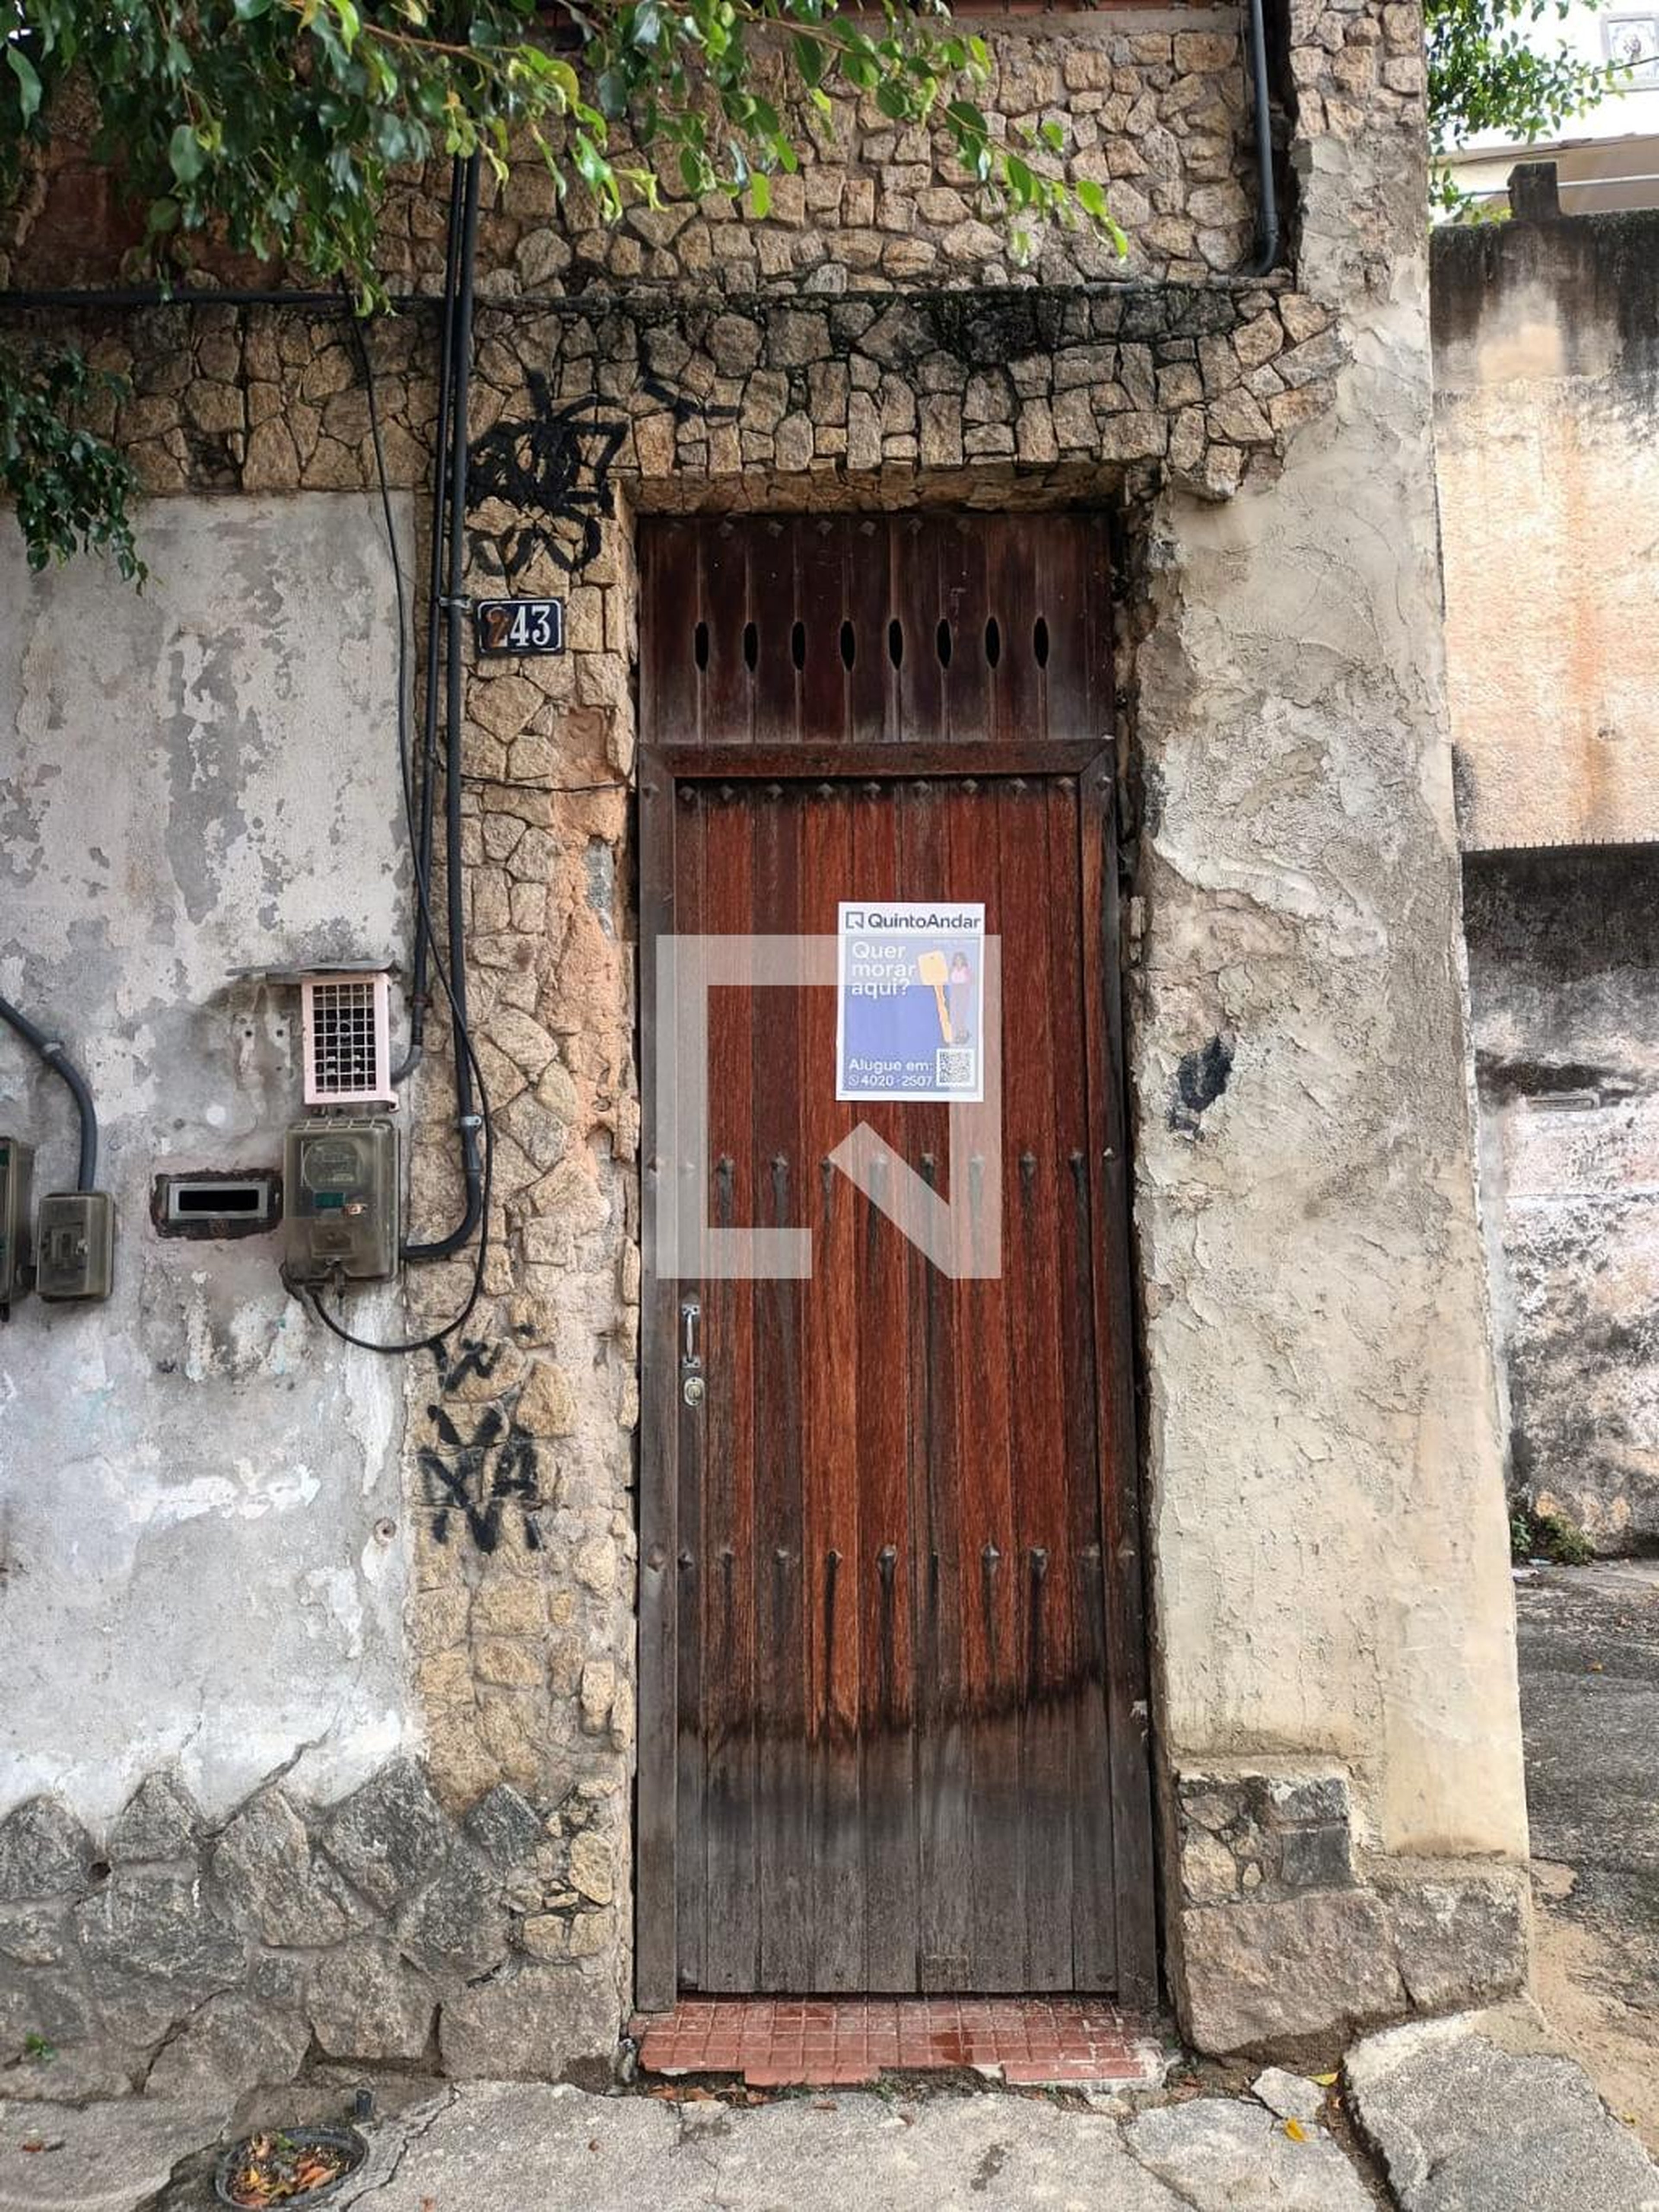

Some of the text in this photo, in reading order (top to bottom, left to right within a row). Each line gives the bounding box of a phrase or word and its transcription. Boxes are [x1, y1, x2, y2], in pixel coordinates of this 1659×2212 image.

[868, 913, 981, 929] QuintoAndar
[852, 941, 906, 958] Quer
[852, 962, 915, 977] morar
[851, 978, 909, 998] aqui?
[849, 1059, 902, 1074] Alugue
